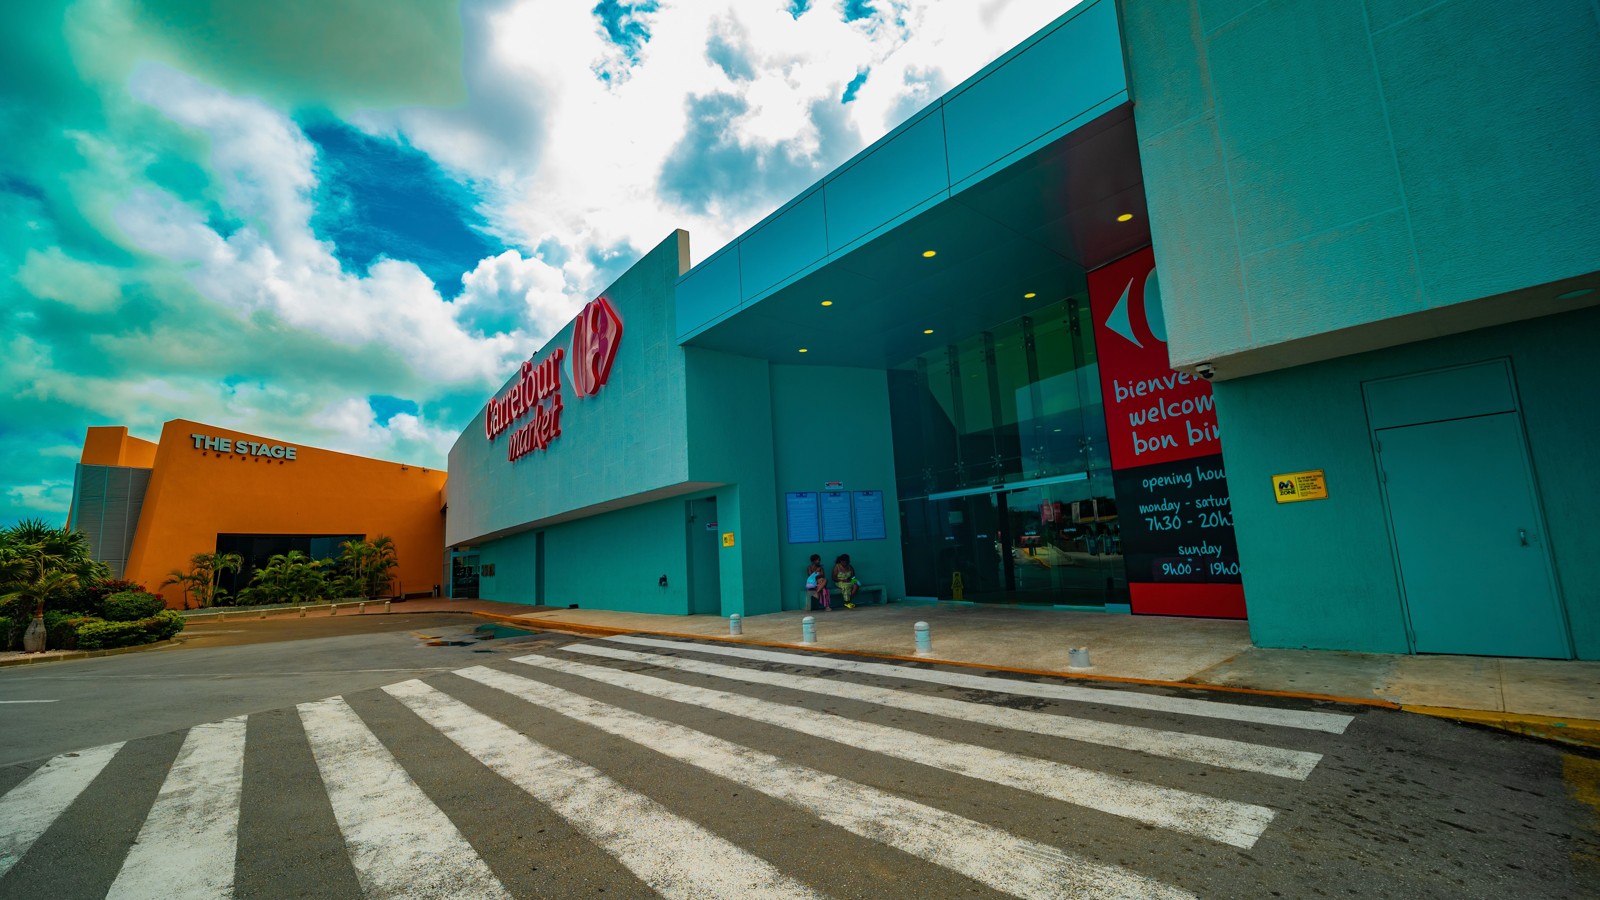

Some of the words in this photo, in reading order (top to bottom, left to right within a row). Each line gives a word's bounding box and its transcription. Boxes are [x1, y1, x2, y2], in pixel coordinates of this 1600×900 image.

[486, 348, 564, 440] Carrefour
[1114, 371, 1198, 403] bienve
[508, 394, 563, 461] market
[191, 434, 232, 452] THE
[235, 440, 297, 460] STAGE
[1132, 430, 1178, 456] bon
[1142, 472, 1192, 493] opening
[1197, 466, 1226, 482] hou
[1139, 497, 1180, 515] monday
[1145, 515, 1181, 531] 7h30
[1178, 540, 1222, 558] sunday
[1162, 562, 1192, 575] 9h00
[1209, 561, 1241, 575] 19h0
